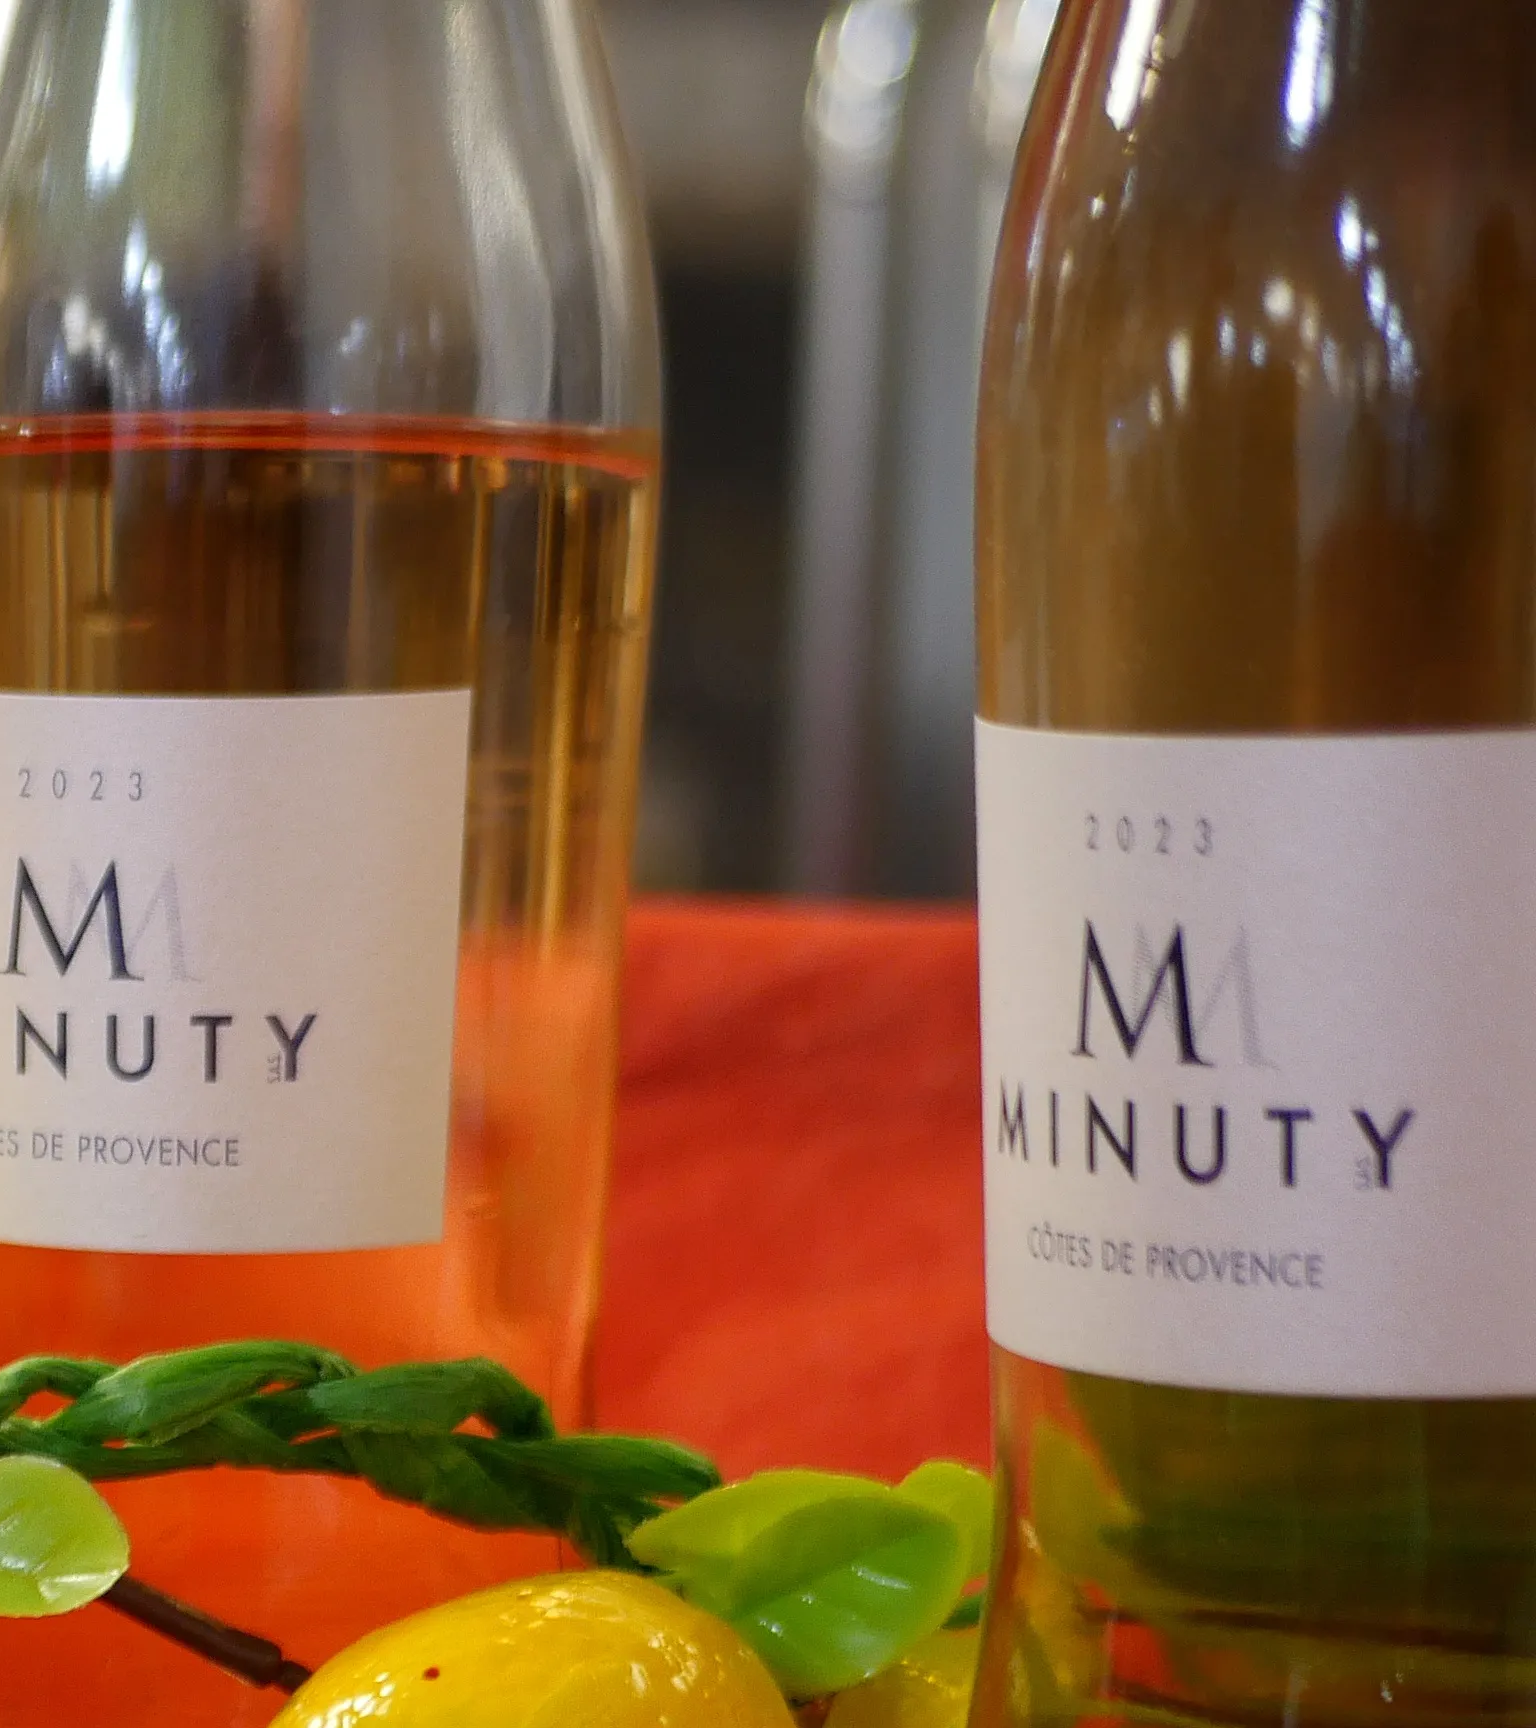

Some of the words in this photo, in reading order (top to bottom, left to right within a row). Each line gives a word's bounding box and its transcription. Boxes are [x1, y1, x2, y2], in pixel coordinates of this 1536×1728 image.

[17, 766, 145, 803] 2023
[1084, 812, 1215, 858] 2023
[31, 1129, 65, 1162] DE
[77, 1133, 240, 1168] PROVENCE
[997, 1076, 1415, 1190] MINUTY
[1029, 1220, 1094, 1270] CÔTES
[1100, 1238, 1135, 1277] DE
[1145, 1242, 1324, 1290] PROVENCE
